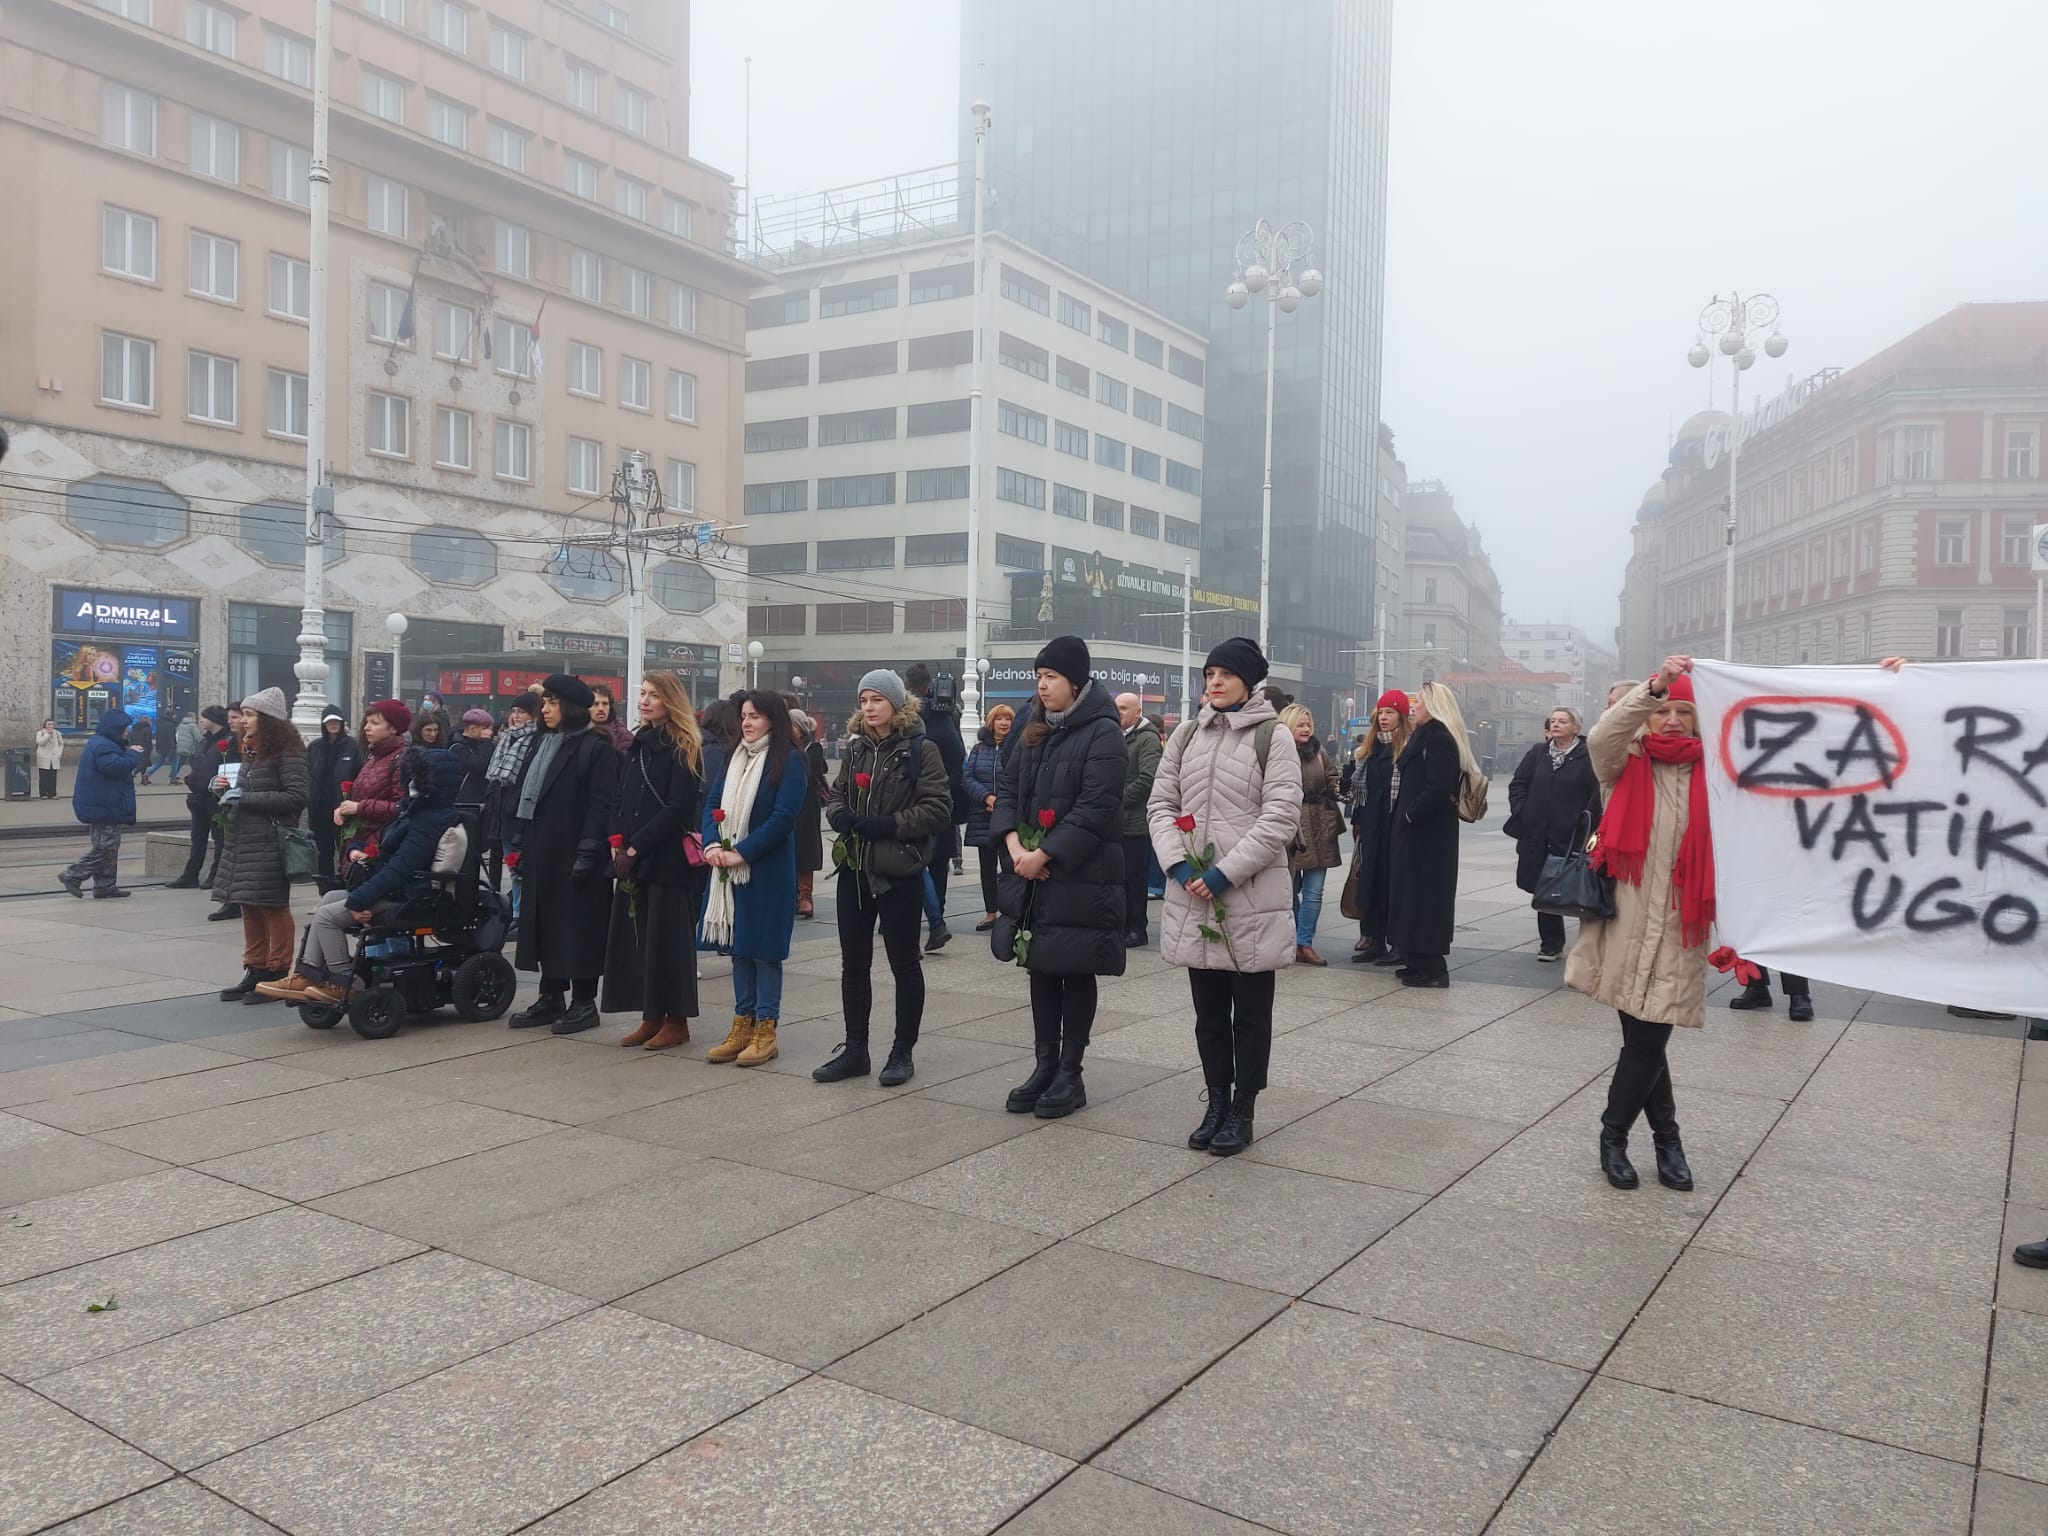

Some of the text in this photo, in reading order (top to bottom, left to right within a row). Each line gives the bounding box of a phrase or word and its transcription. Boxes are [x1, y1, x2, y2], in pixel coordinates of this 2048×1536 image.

[1117, 571, 1146, 592] UŽIVANJE
[1146, 577, 1152, 593] U
[1152, 580, 1171, 596] RITMU
[77, 602, 177, 624] ADMIRAL
[98, 617, 161, 627] AUTOMAT CLUB
[1110, 668, 1131, 685] bolja
[1132, 671, 1160, 686] puda
[1736, 704, 1902, 790] ZA
